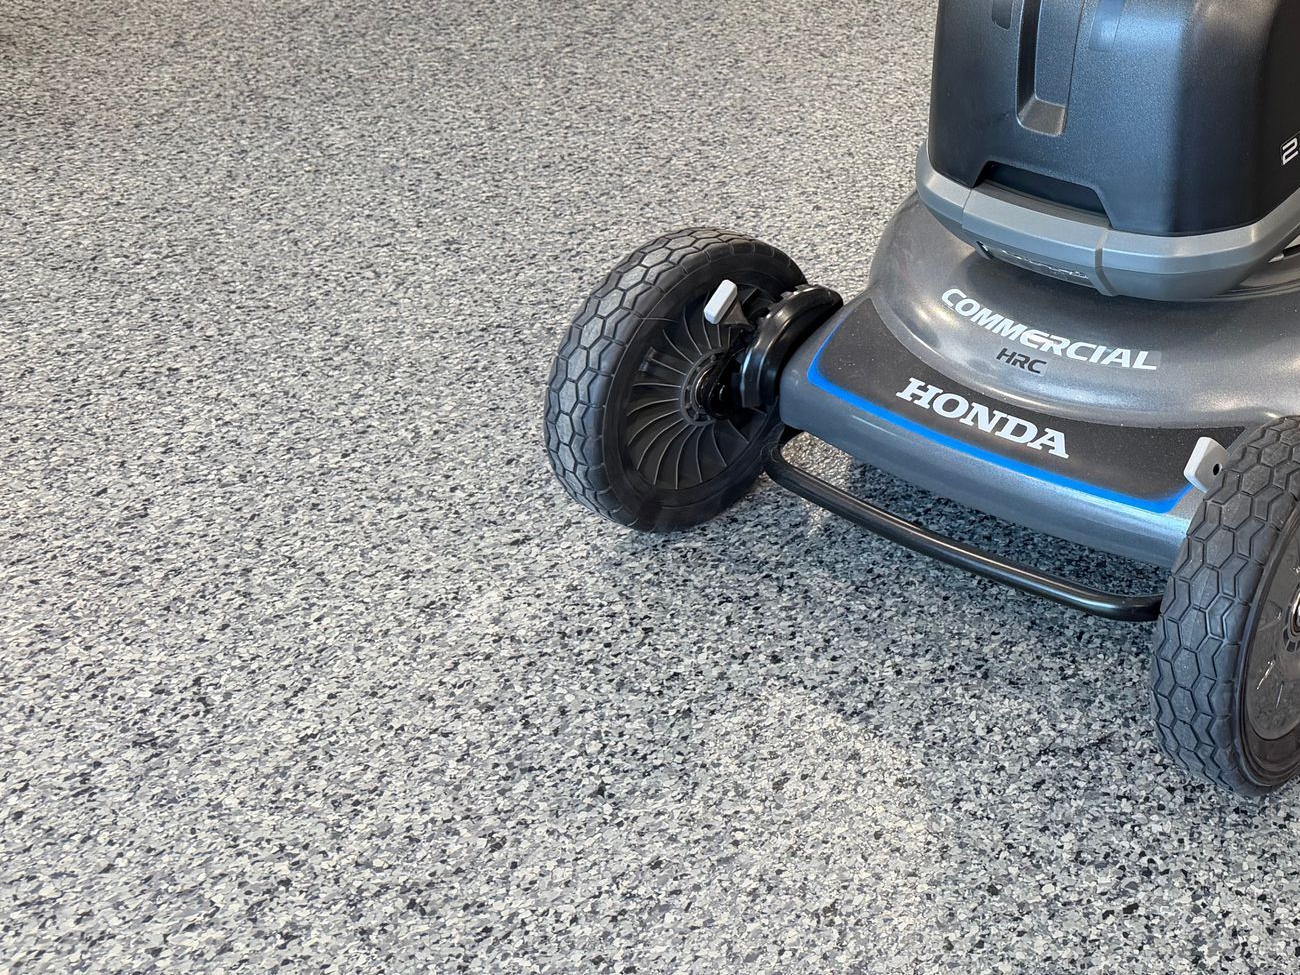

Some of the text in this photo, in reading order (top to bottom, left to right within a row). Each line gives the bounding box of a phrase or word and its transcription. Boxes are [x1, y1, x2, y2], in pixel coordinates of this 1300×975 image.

[941, 288, 1158, 371] COMMERCIAL
[995, 347, 1048, 375] HRC
[895, 377, 1071, 460] HONDA
